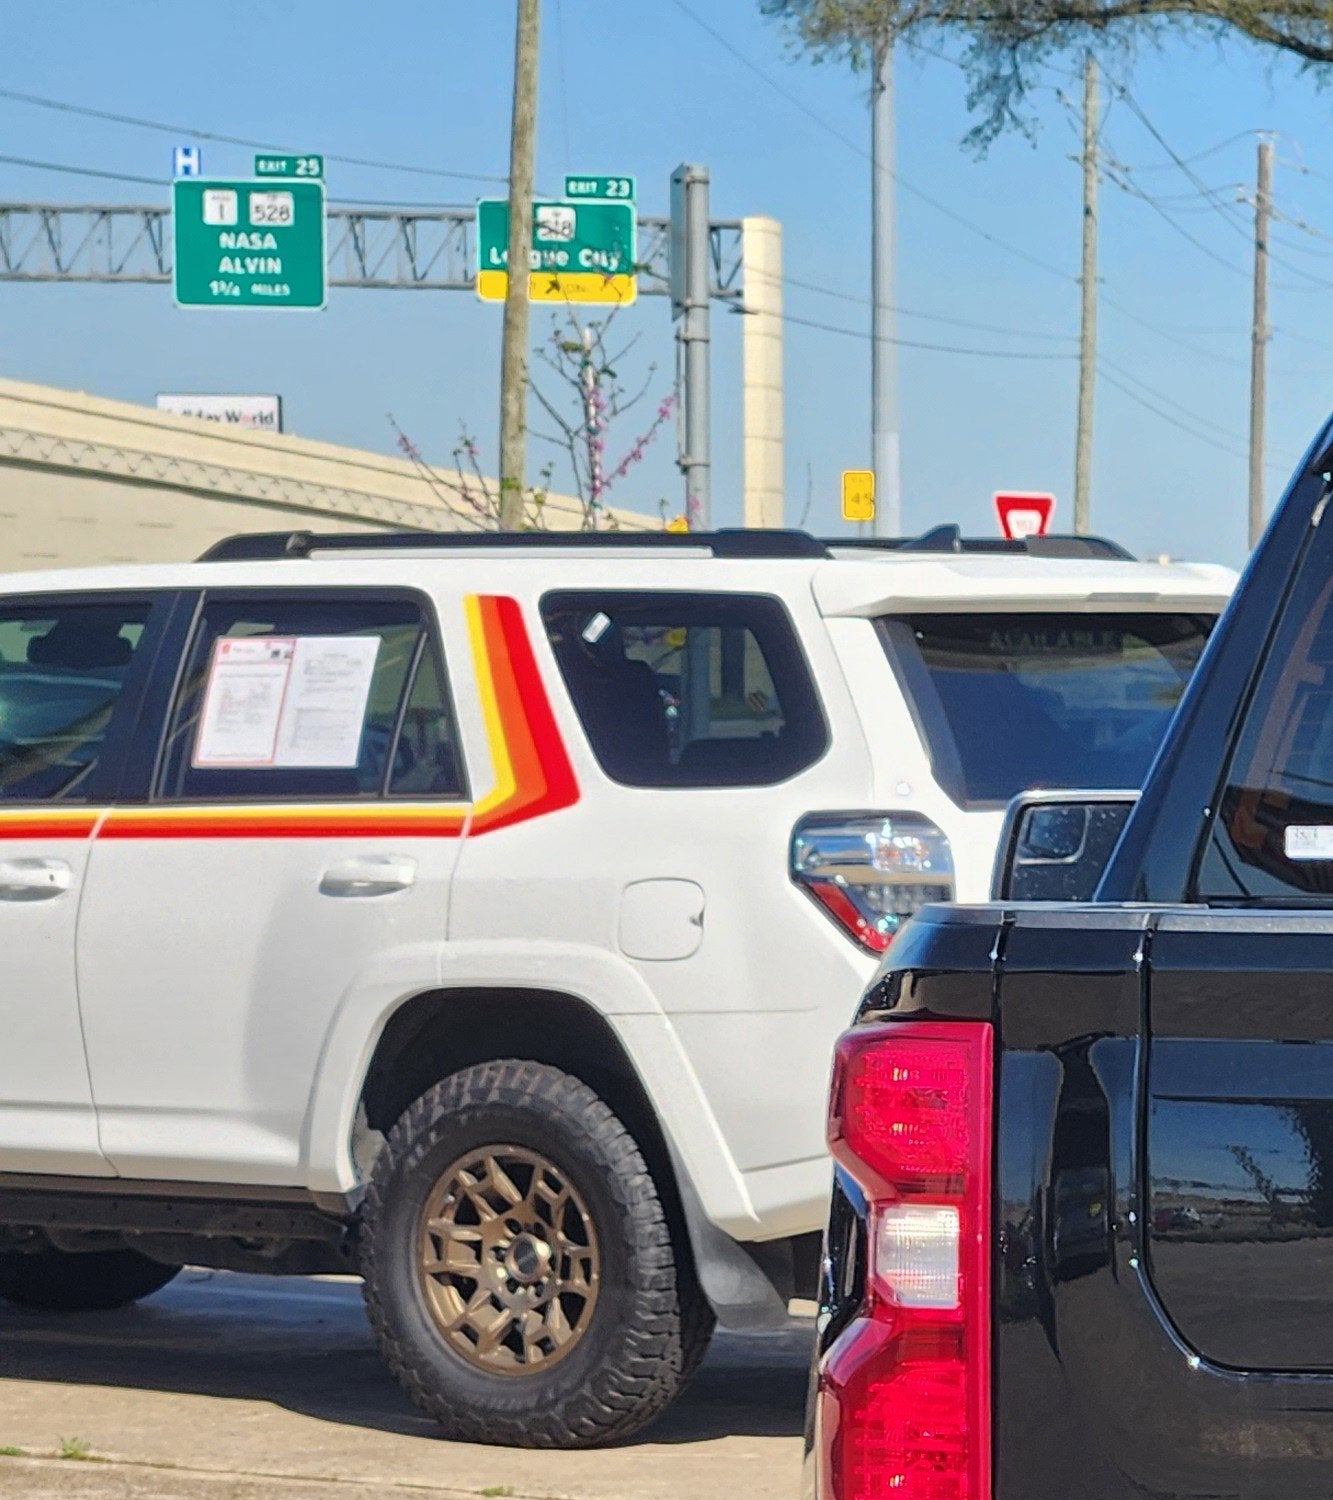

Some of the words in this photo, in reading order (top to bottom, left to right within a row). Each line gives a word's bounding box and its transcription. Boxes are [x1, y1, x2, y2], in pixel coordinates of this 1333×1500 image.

[257, 160, 287, 171] EXIT
[295, 158, 320, 175] 25
[568, 181, 598, 194] EXIT
[605, 180, 630, 197] 23
[254, 205, 291, 222] 528
[219, 232, 278, 249] NASA
[218, 256, 282, 274] ALVIN
[489, 247, 570, 269] Lgue
[578, 248, 621, 271] City
[251, 283, 291, 296] MILES
